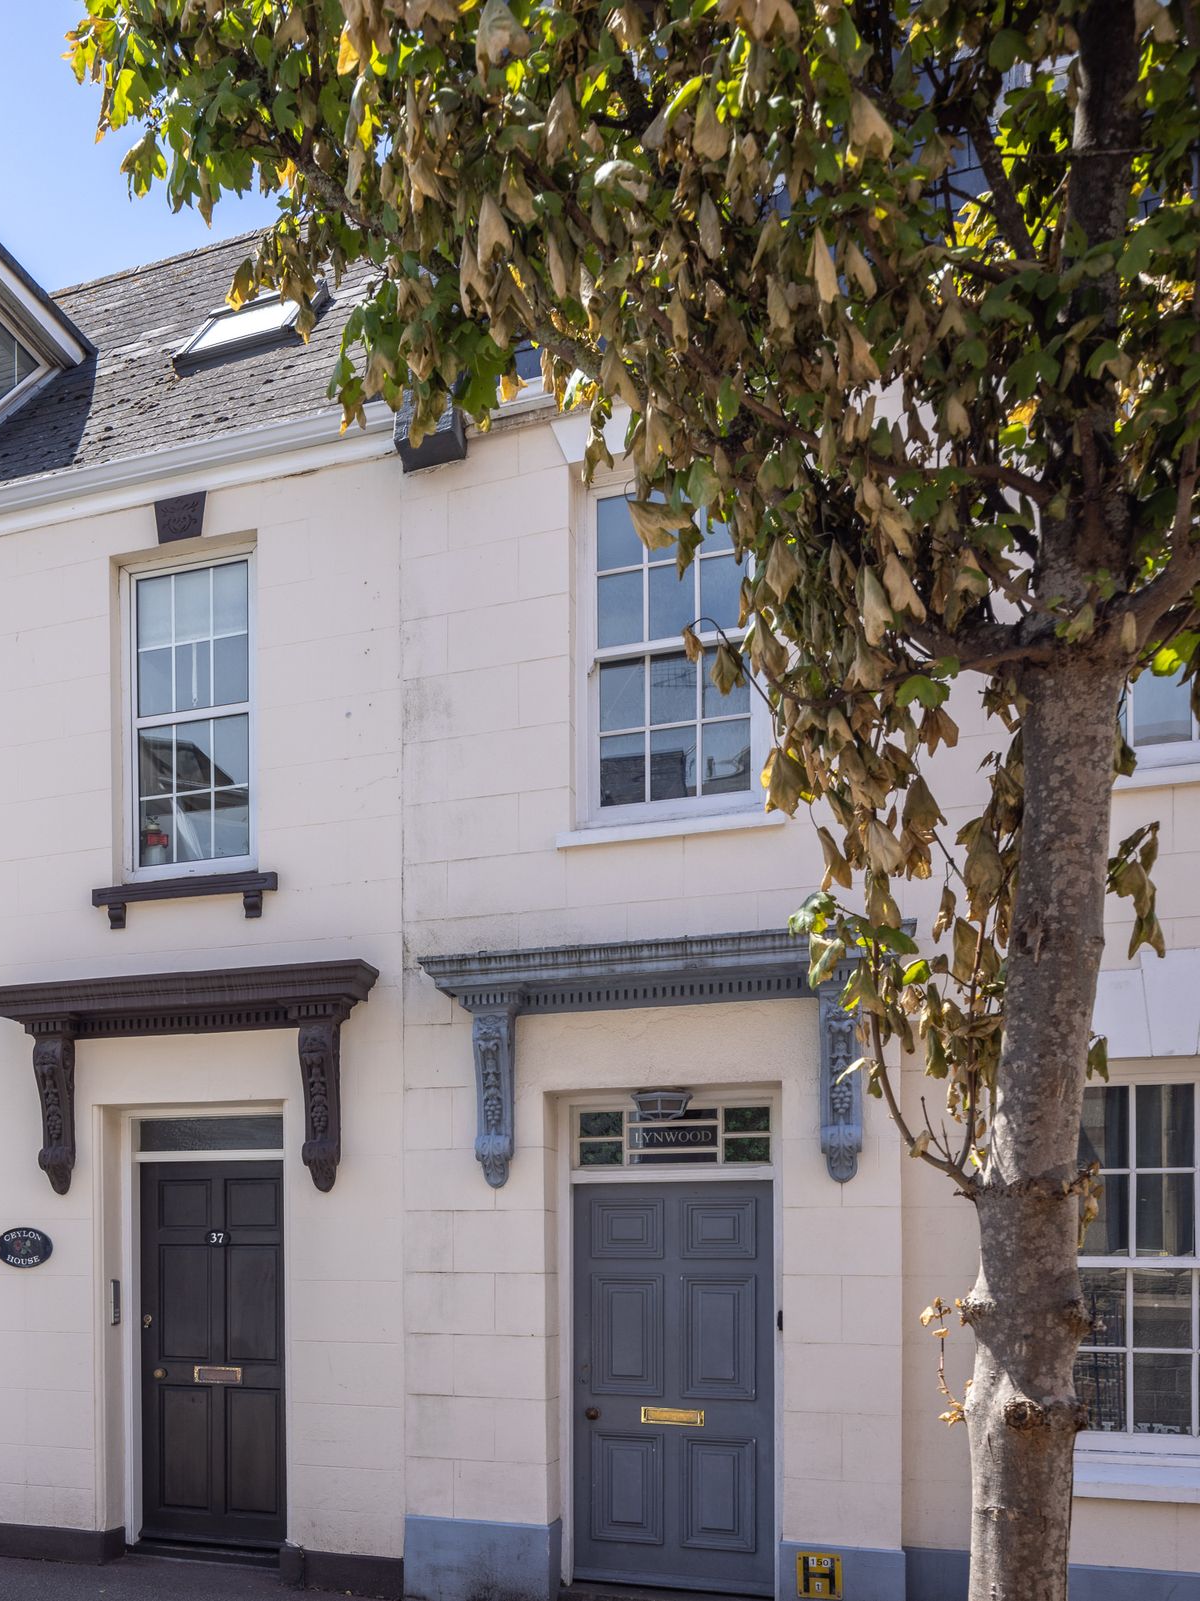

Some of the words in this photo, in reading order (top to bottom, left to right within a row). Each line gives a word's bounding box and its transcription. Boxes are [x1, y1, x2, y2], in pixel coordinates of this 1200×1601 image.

[635, 1130, 712, 1143] LYNWOOD
[3, 1230, 41, 1241] CEYLON
[210, 1232, 224, 1243] 37
[6, 1255, 40, 1265] HOUSE
[810, 1558, 829, 1567] 150
